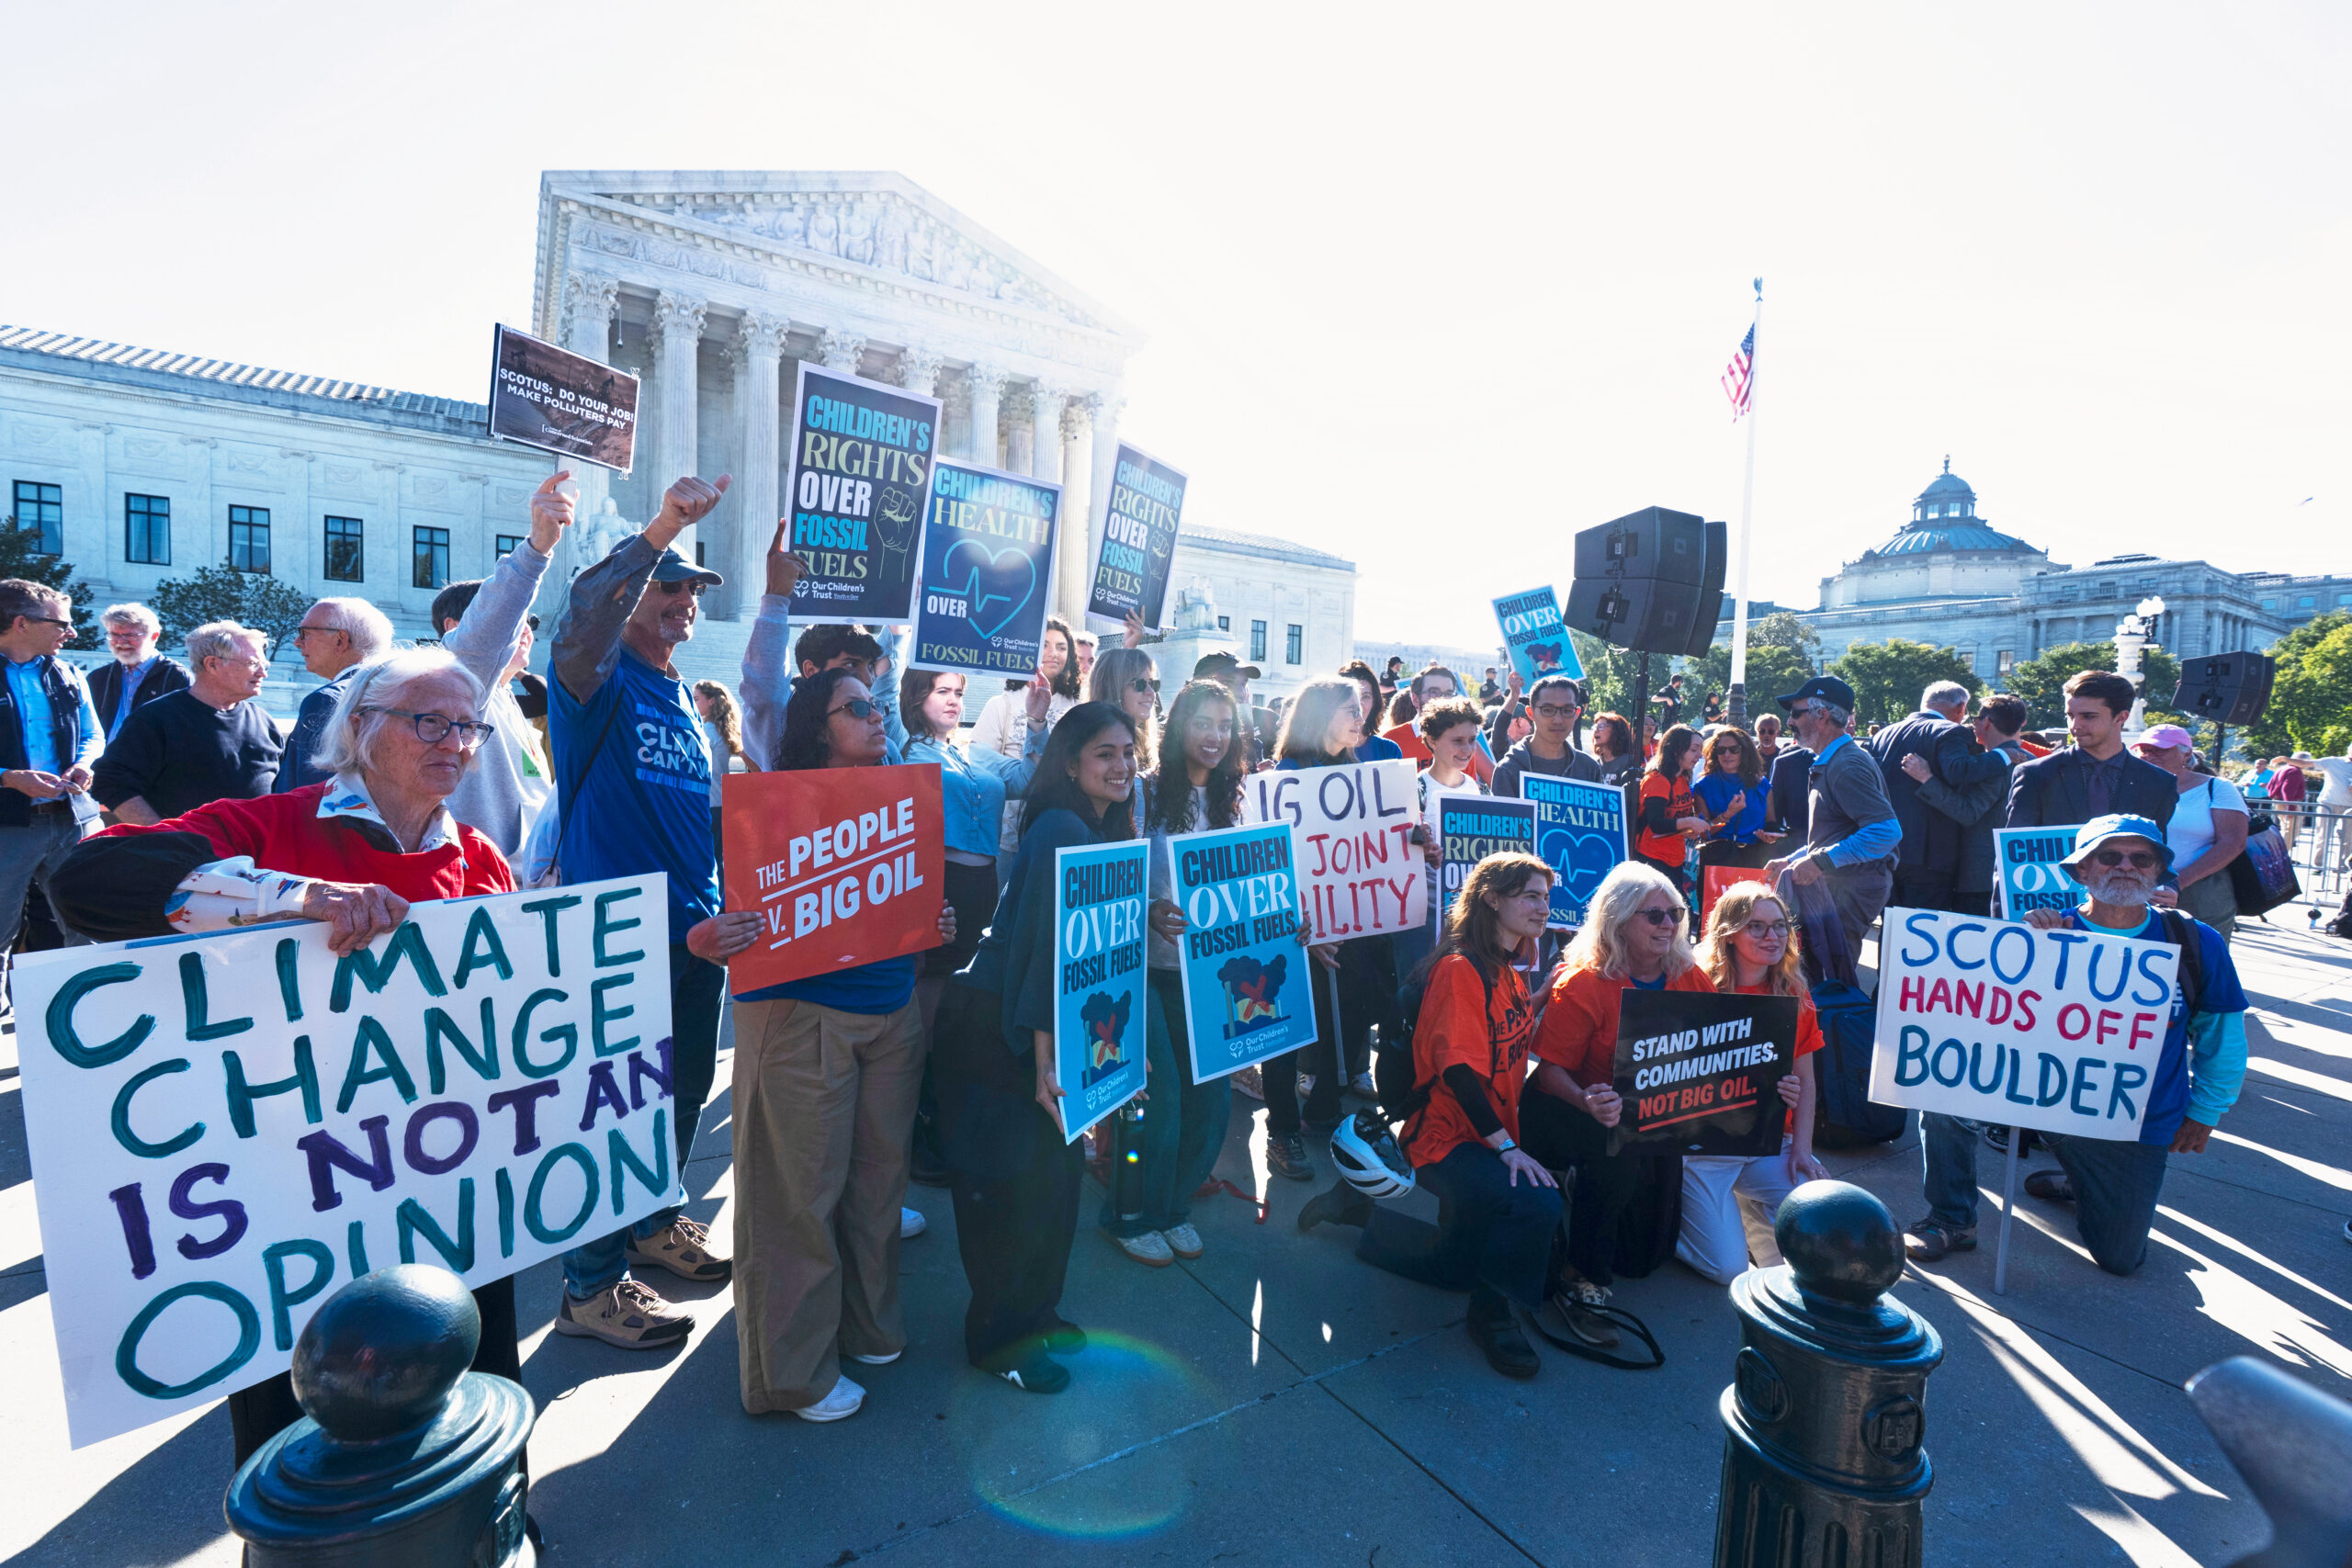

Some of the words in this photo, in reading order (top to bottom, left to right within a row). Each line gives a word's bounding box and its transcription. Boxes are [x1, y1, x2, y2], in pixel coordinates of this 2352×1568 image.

[499, 367, 553, 395] SCOTUS:
[559, 389, 575, 402] DO
[579, 394, 608, 413] YOUR
[610, 407, 634, 423] JOB!
[507, 384, 541, 402] MAKE
[544, 395, 605, 423] POLLUTERS
[606, 417, 627, 430] PAY
[807, 395, 931, 452] CHILDREN'S
[802, 431, 926, 487] RIGHTS
[799, 470, 873, 517] OVER
[934, 468, 1054, 518] CHILDREN'S
[1112, 484, 1178, 533] RIGHTS
[1117, 459, 1182, 509] CHILDREN'S
[795, 513, 868, 551] FOSSIL
[933, 497, 1050, 546] HEALTH
[1108, 513, 1148, 550] OVER
[1097, 566, 1142, 595] FUELS
[1102, 540, 1144, 575] FOSSIL
[812, 581, 827, 590] Our
[827, 582, 865, 592] Children's
[812, 590, 832, 599] Trust
[926, 595, 967, 618] OVER
[1498, 591, 1555, 617] CHILDREN
[1504, 606, 1560, 634] OVER
[1508, 630, 1539, 647] FOSSIL
[1540, 623, 1564, 637] FUELS
[922, 643, 983, 666] FOSSIL
[986, 650, 1035, 671] FUELS
[1259, 777, 1302, 829] IG
[1319, 768, 1408, 821] OIL
[1527, 781, 1619, 812] CHILDREN'S
[755, 860, 786, 889] THE
[789, 797, 915, 878] PEOPLE
[1306, 822, 1414, 876] JOINT
[1444, 812, 1532, 839] CHILDREN'S
[2007, 836, 2076, 863] CHIL
[1065, 857, 1144, 909] CHILDREN
[1182, 836, 1288, 887] CHILDREN
[2012, 863, 2073, 892] OV
[768, 904, 786, 935] V.
[794, 875, 860, 940] BIG
[867, 851, 924, 906] OIL
[1189, 873, 1292, 930] OVER
[1066, 898, 1141, 959] OVER
[1191, 924, 1250, 960] FOSSIL
[1253, 910, 1297, 944] FUELS
[45, 886, 646, 1070] CLIMATE
[1064, 953, 1107, 996] FOSSIL
[1110, 941, 1141, 977] FUELS
[1901, 912, 2174, 1008] SCOTUS
[1246, 1037, 1259, 1045] Our
[1259, 1025, 1288, 1042] Children's
[1899, 975, 2042, 1032] HANDS
[2056, 1002, 2159, 1051] OFF
[1247, 1043, 1264, 1054] Trust
[1632, 1029, 1698, 1062] STAND
[1702, 1017, 1753, 1047] WITH
[110, 972, 641, 1159] CHANGE
[1635, 1042, 1779, 1090] COMMUNITIES.
[1894, 1024, 2147, 1122] BOULDER
[1639, 1091, 1679, 1121] NOT
[1679, 1083, 1714, 1110] BIG
[1720, 1076, 1757, 1100] OIL.
[108, 1162, 250, 1280] IS
[297, 1078, 560, 1213] NOT
[579, 1036, 674, 1132] AN
[116, 1108, 671, 1402] OPINION
